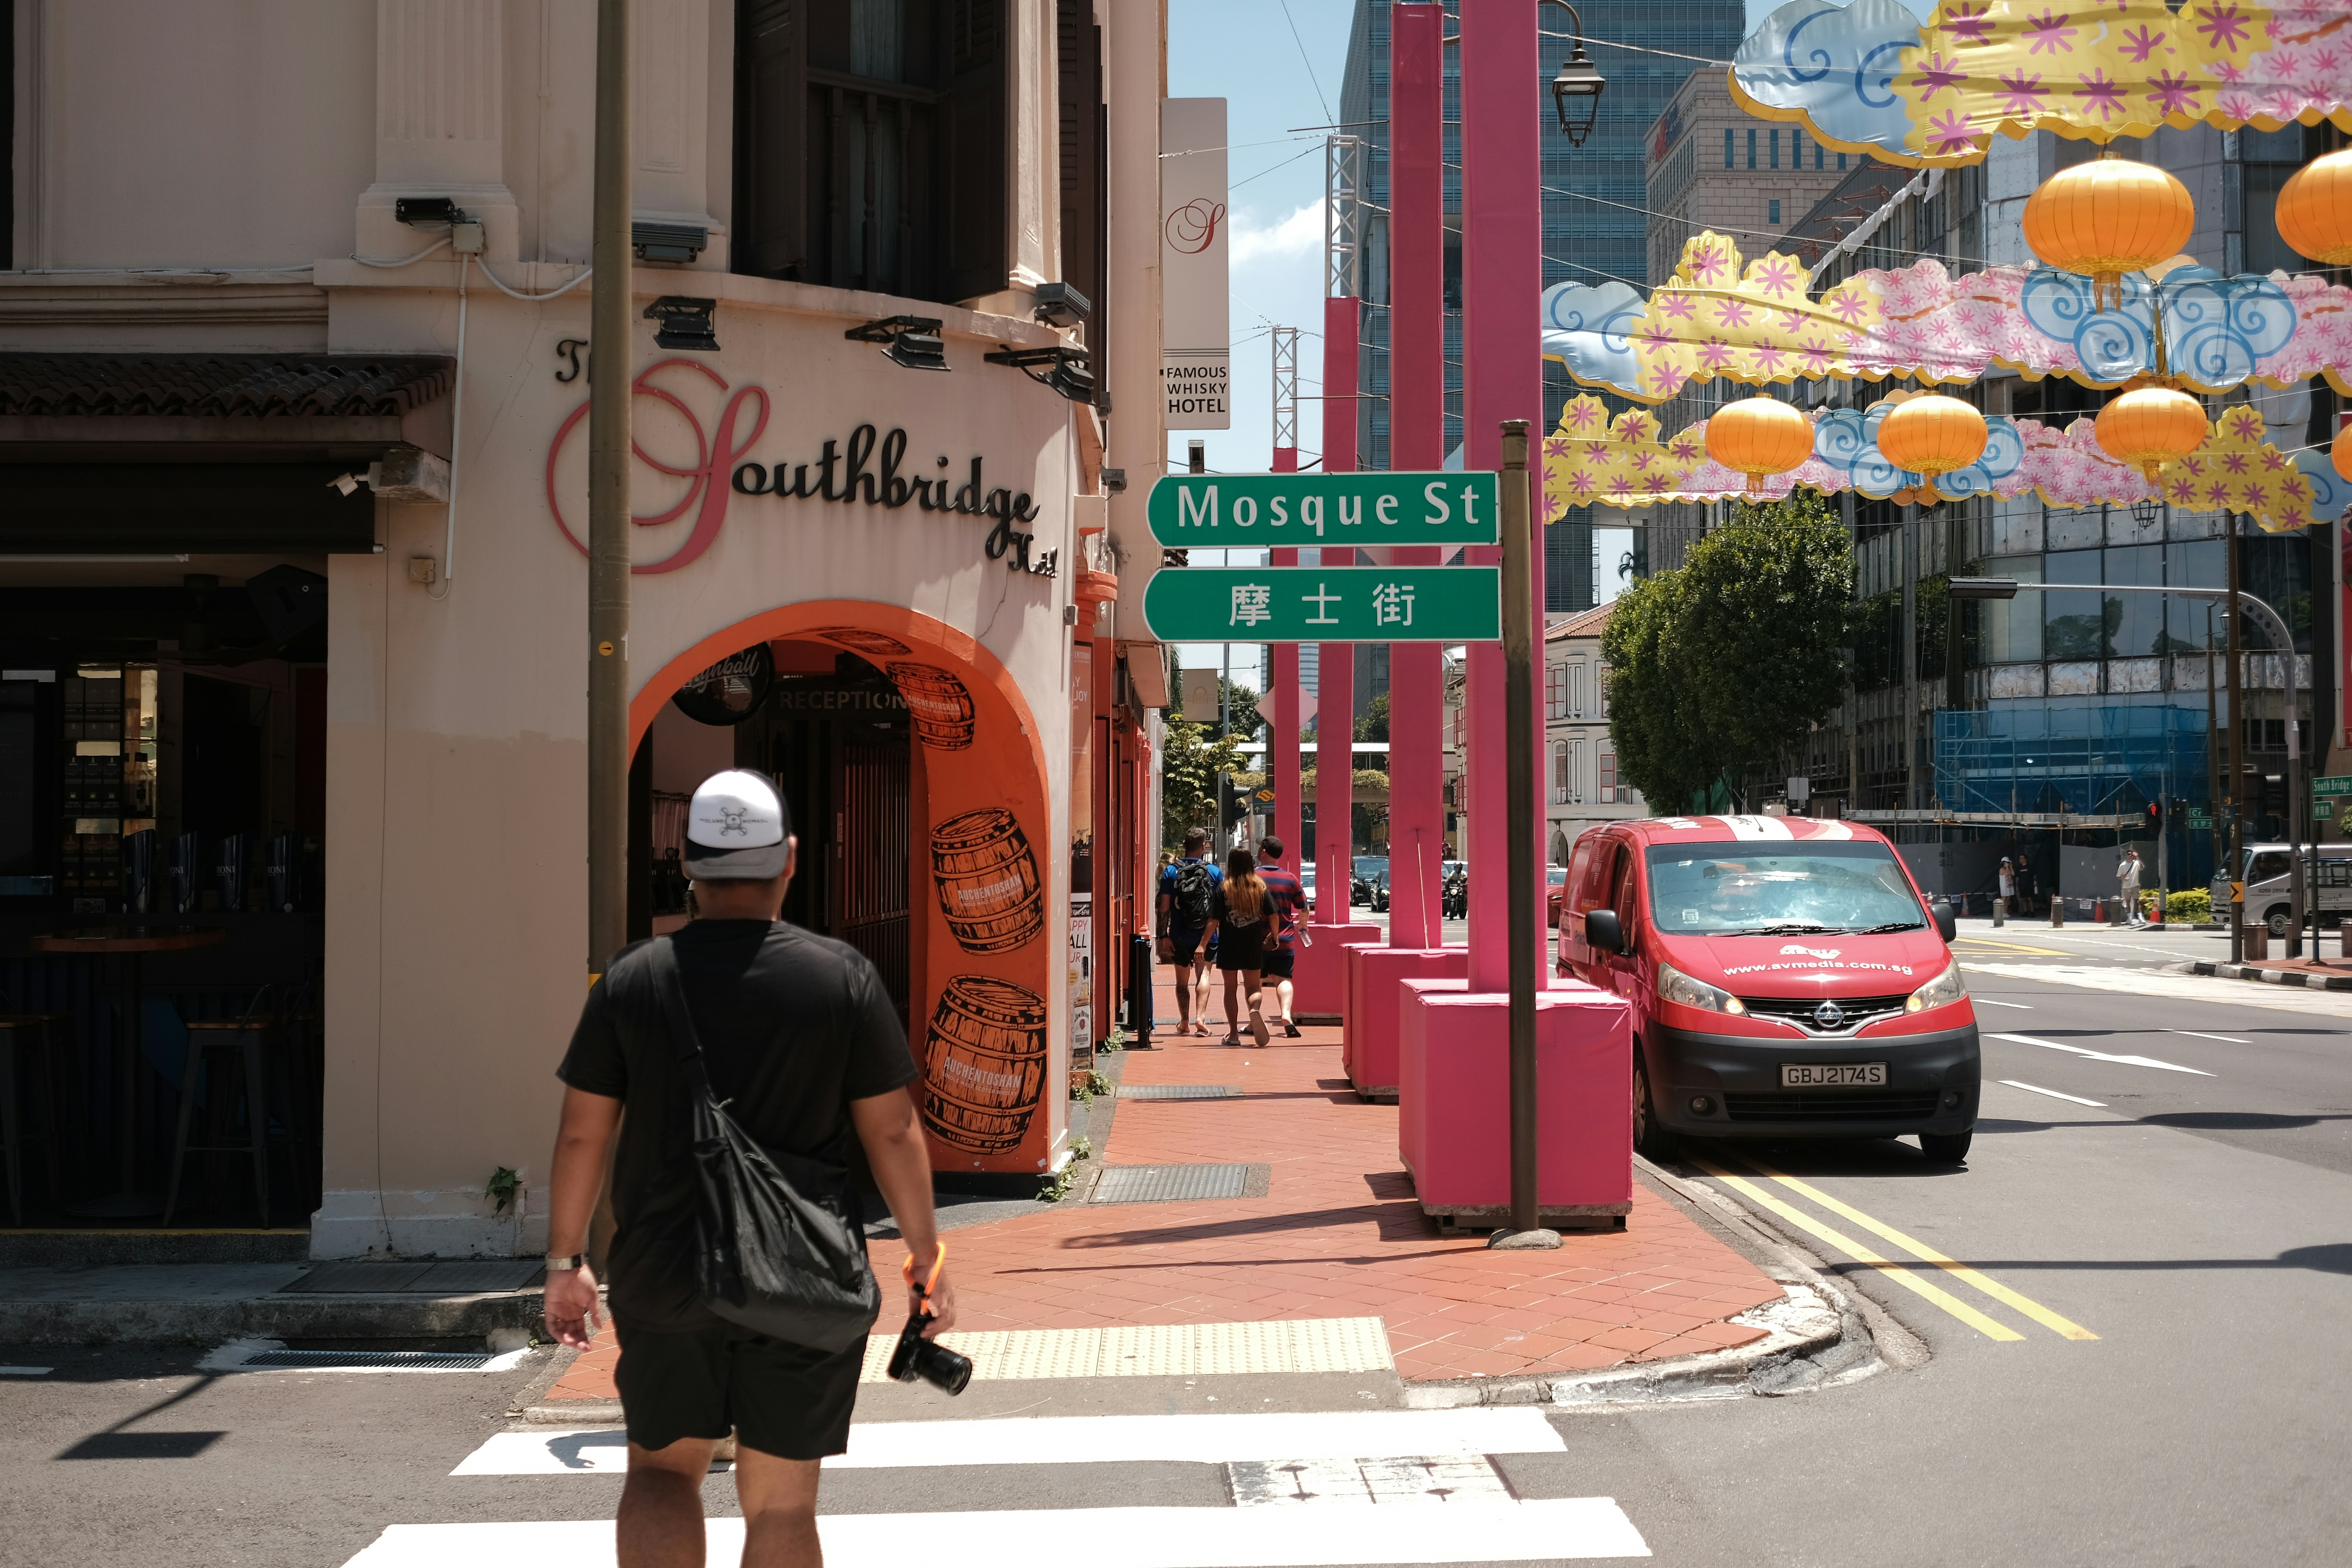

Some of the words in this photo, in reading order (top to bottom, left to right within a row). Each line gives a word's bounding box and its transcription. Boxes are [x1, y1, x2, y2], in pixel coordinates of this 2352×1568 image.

[1166, 367, 1227, 379] FAMOUS
[1167, 383, 1227, 395] WHISKY
[1168, 398, 1226, 414] HOTEL
[1178, 485, 1399, 536] Mosque
[1425, 482, 1479, 524] St
[1009, 532, 1058, 578] Hotel
[1229, 583, 1416, 627] 摩士街
[1074, 651, 1090, 660] ENTOSHAN
[780, 691, 907, 710] RECEPTION
[908, 695, 960, 711] AUCHENTOSHAN
[1074, 690, 1087, 702] JOY
[2314, 780, 2330, 791] South
[2331, 779, 2349, 793] Bridge
[2314, 806, 2330, 816] 桥南路
[267, 866, 285, 874] RONI
[958, 873, 1022, 901] AUCHENTOSHAN
[989, 895, 1006, 903] SCOTCH
[1006, 886, 1022, 897] WHISKY
[1070, 920, 1088, 931] PPY
[1070, 933, 1087, 949] ALL
[1070, 952, 1081, 963] UR
[1723, 961, 1913, 976] www.avmedia.com.sg
[943, 1056, 1023, 1088] AUCHENTOSHAN
[1788, 1067, 1880, 1083] GBJ2174S
[942, 1071, 959, 1083] SINGLE
[960, 1080, 975, 1089] MALT
[975, 1085, 996, 1094] SCOTCH
